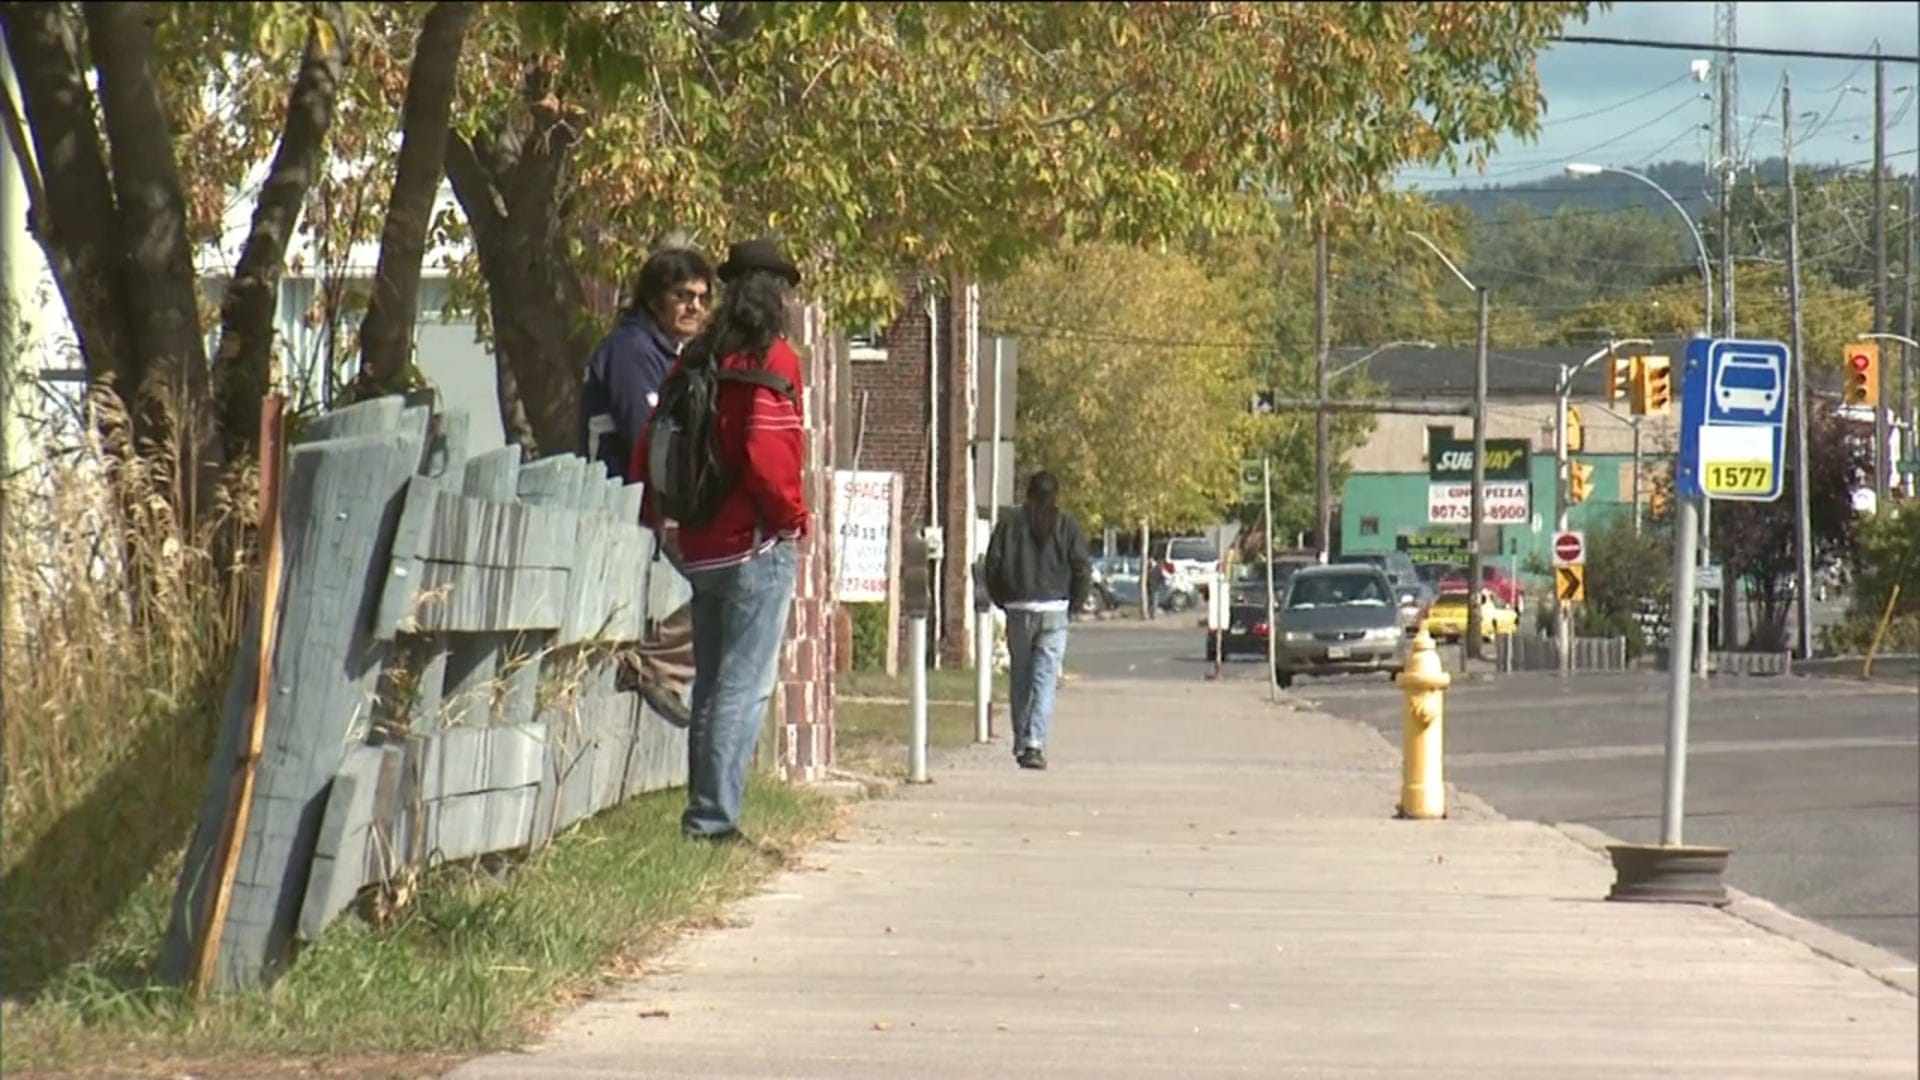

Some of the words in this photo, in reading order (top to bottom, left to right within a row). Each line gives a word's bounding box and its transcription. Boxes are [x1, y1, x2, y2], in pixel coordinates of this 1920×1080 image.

[1712, 467, 1766, 487] 1577
[844, 482, 890, 500] SPACE
[1486, 488, 1523, 498] PIZZA
[1431, 505, 1526, 519] 807-3-8900
